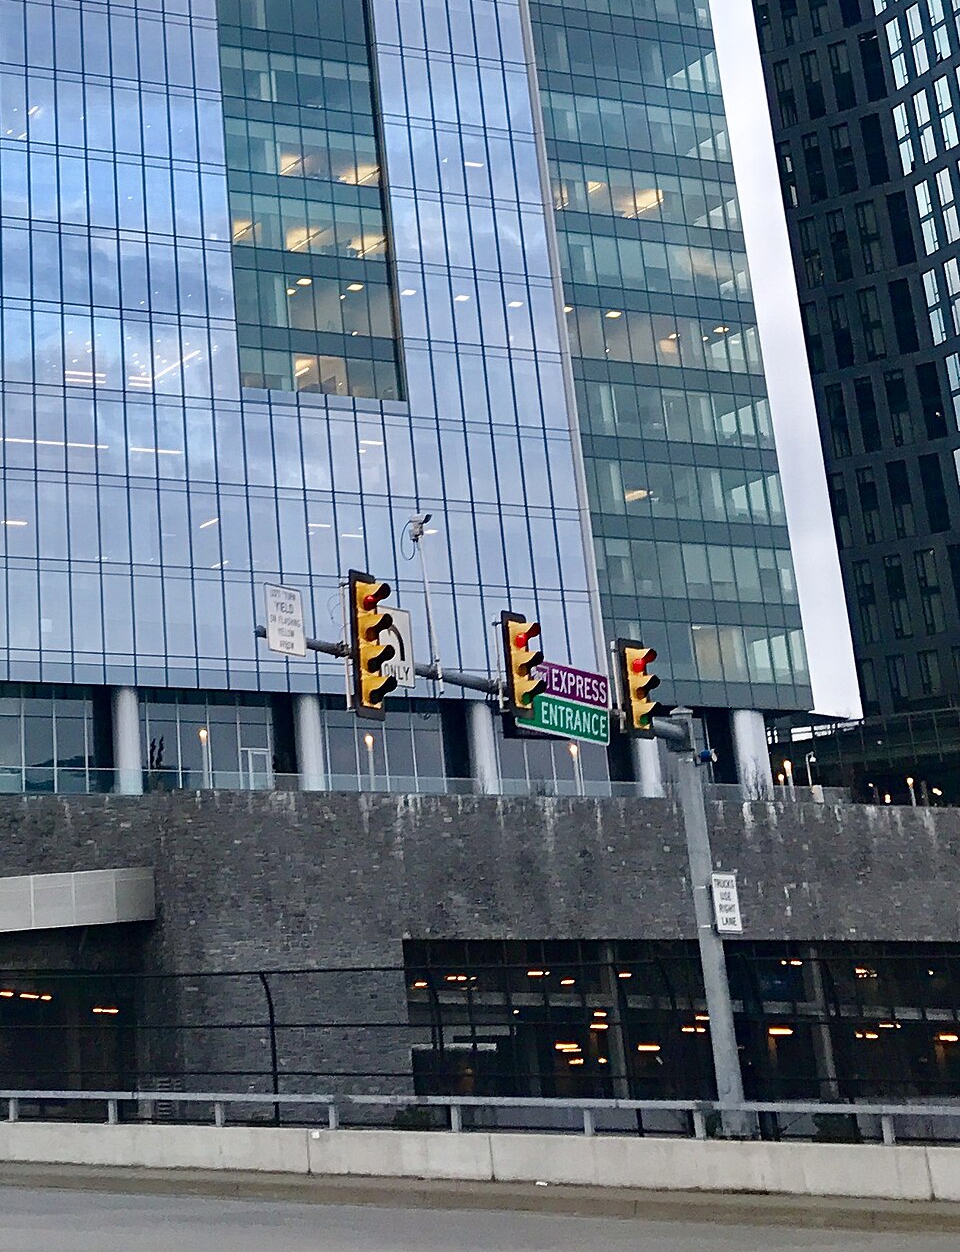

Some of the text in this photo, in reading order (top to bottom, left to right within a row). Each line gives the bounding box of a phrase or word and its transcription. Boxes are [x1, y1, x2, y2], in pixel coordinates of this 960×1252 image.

[273, 600, 295, 614] YIELD
[382, 662, 410, 681] ONLY
[551, 668, 607, 704] EXPRESS
[541, 701, 608, 738] ENTRANCE
